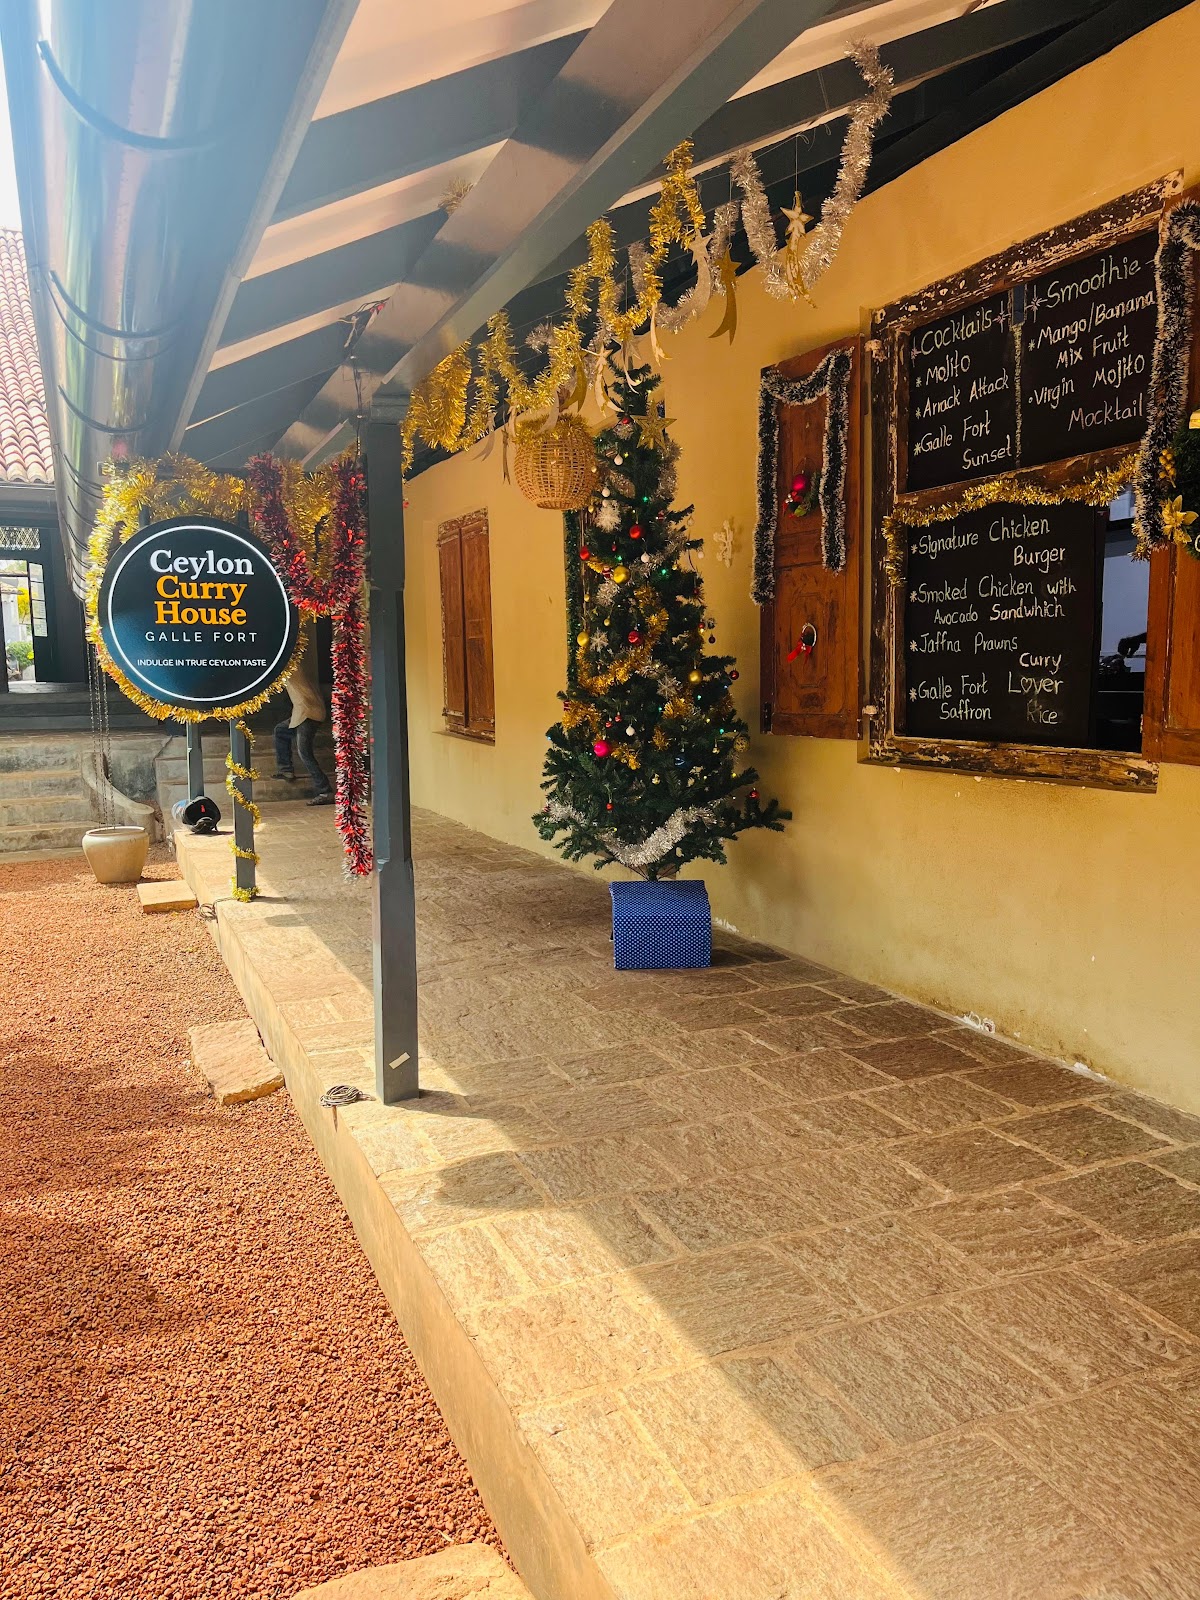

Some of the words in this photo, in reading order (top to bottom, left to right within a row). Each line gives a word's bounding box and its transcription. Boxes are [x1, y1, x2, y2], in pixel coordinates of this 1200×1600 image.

[1047, 256, 1140, 308] Smoothie
[921, 307, 992, 355] Cocktails
[1037, 291, 1156, 348] Mango/Banana
[1056, 348, 1082, 369] Mix
[1093, 326, 1129, 357] Fruit
[926, 351, 970, 386] Mojito
[1034, 377, 1074, 408] Virgin
[1093, 354, 1144, 388] Mojito
[923, 385, 960, 418] Arrack
[969, 368, 1008, 402] Attack
[1068, 393, 1143, 431] Mocktail
[921, 425, 952, 453] Galle
[963, 411, 990, 441] Fort
[962, 435, 1011, 469] Sunset
[919, 526, 978, 559] Signature
[989, 515, 1050, 542] Chicken
[150, 550, 254, 580] Ceylon
[1014, 546, 1065, 573] Burger
[156, 575, 247, 606] Curry
[918, 578, 967, 603] Smoked
[978, 574, 1034, 598] Chicken
[1047, 577, 1076, 595] with
[154, 601, 247, 625] House
[934, 604, 978, 624] Avocado
[990, 597, 1065, 621] Sandwhich
[145, 632, 203, 642] GALLE
[214, 632, 257, 642] FORT
[920, 631, 961, 653] Jaffna
[975, 632, 1018, 654] Prawns
[1020, 653, 1062, 674] Curry
[918, 676, 952, 700] Galle
[961, 673, 988, 695] Fort
[939, 699, 991, 720] Saffron
[1026, 699, 1058, 724] Rice
